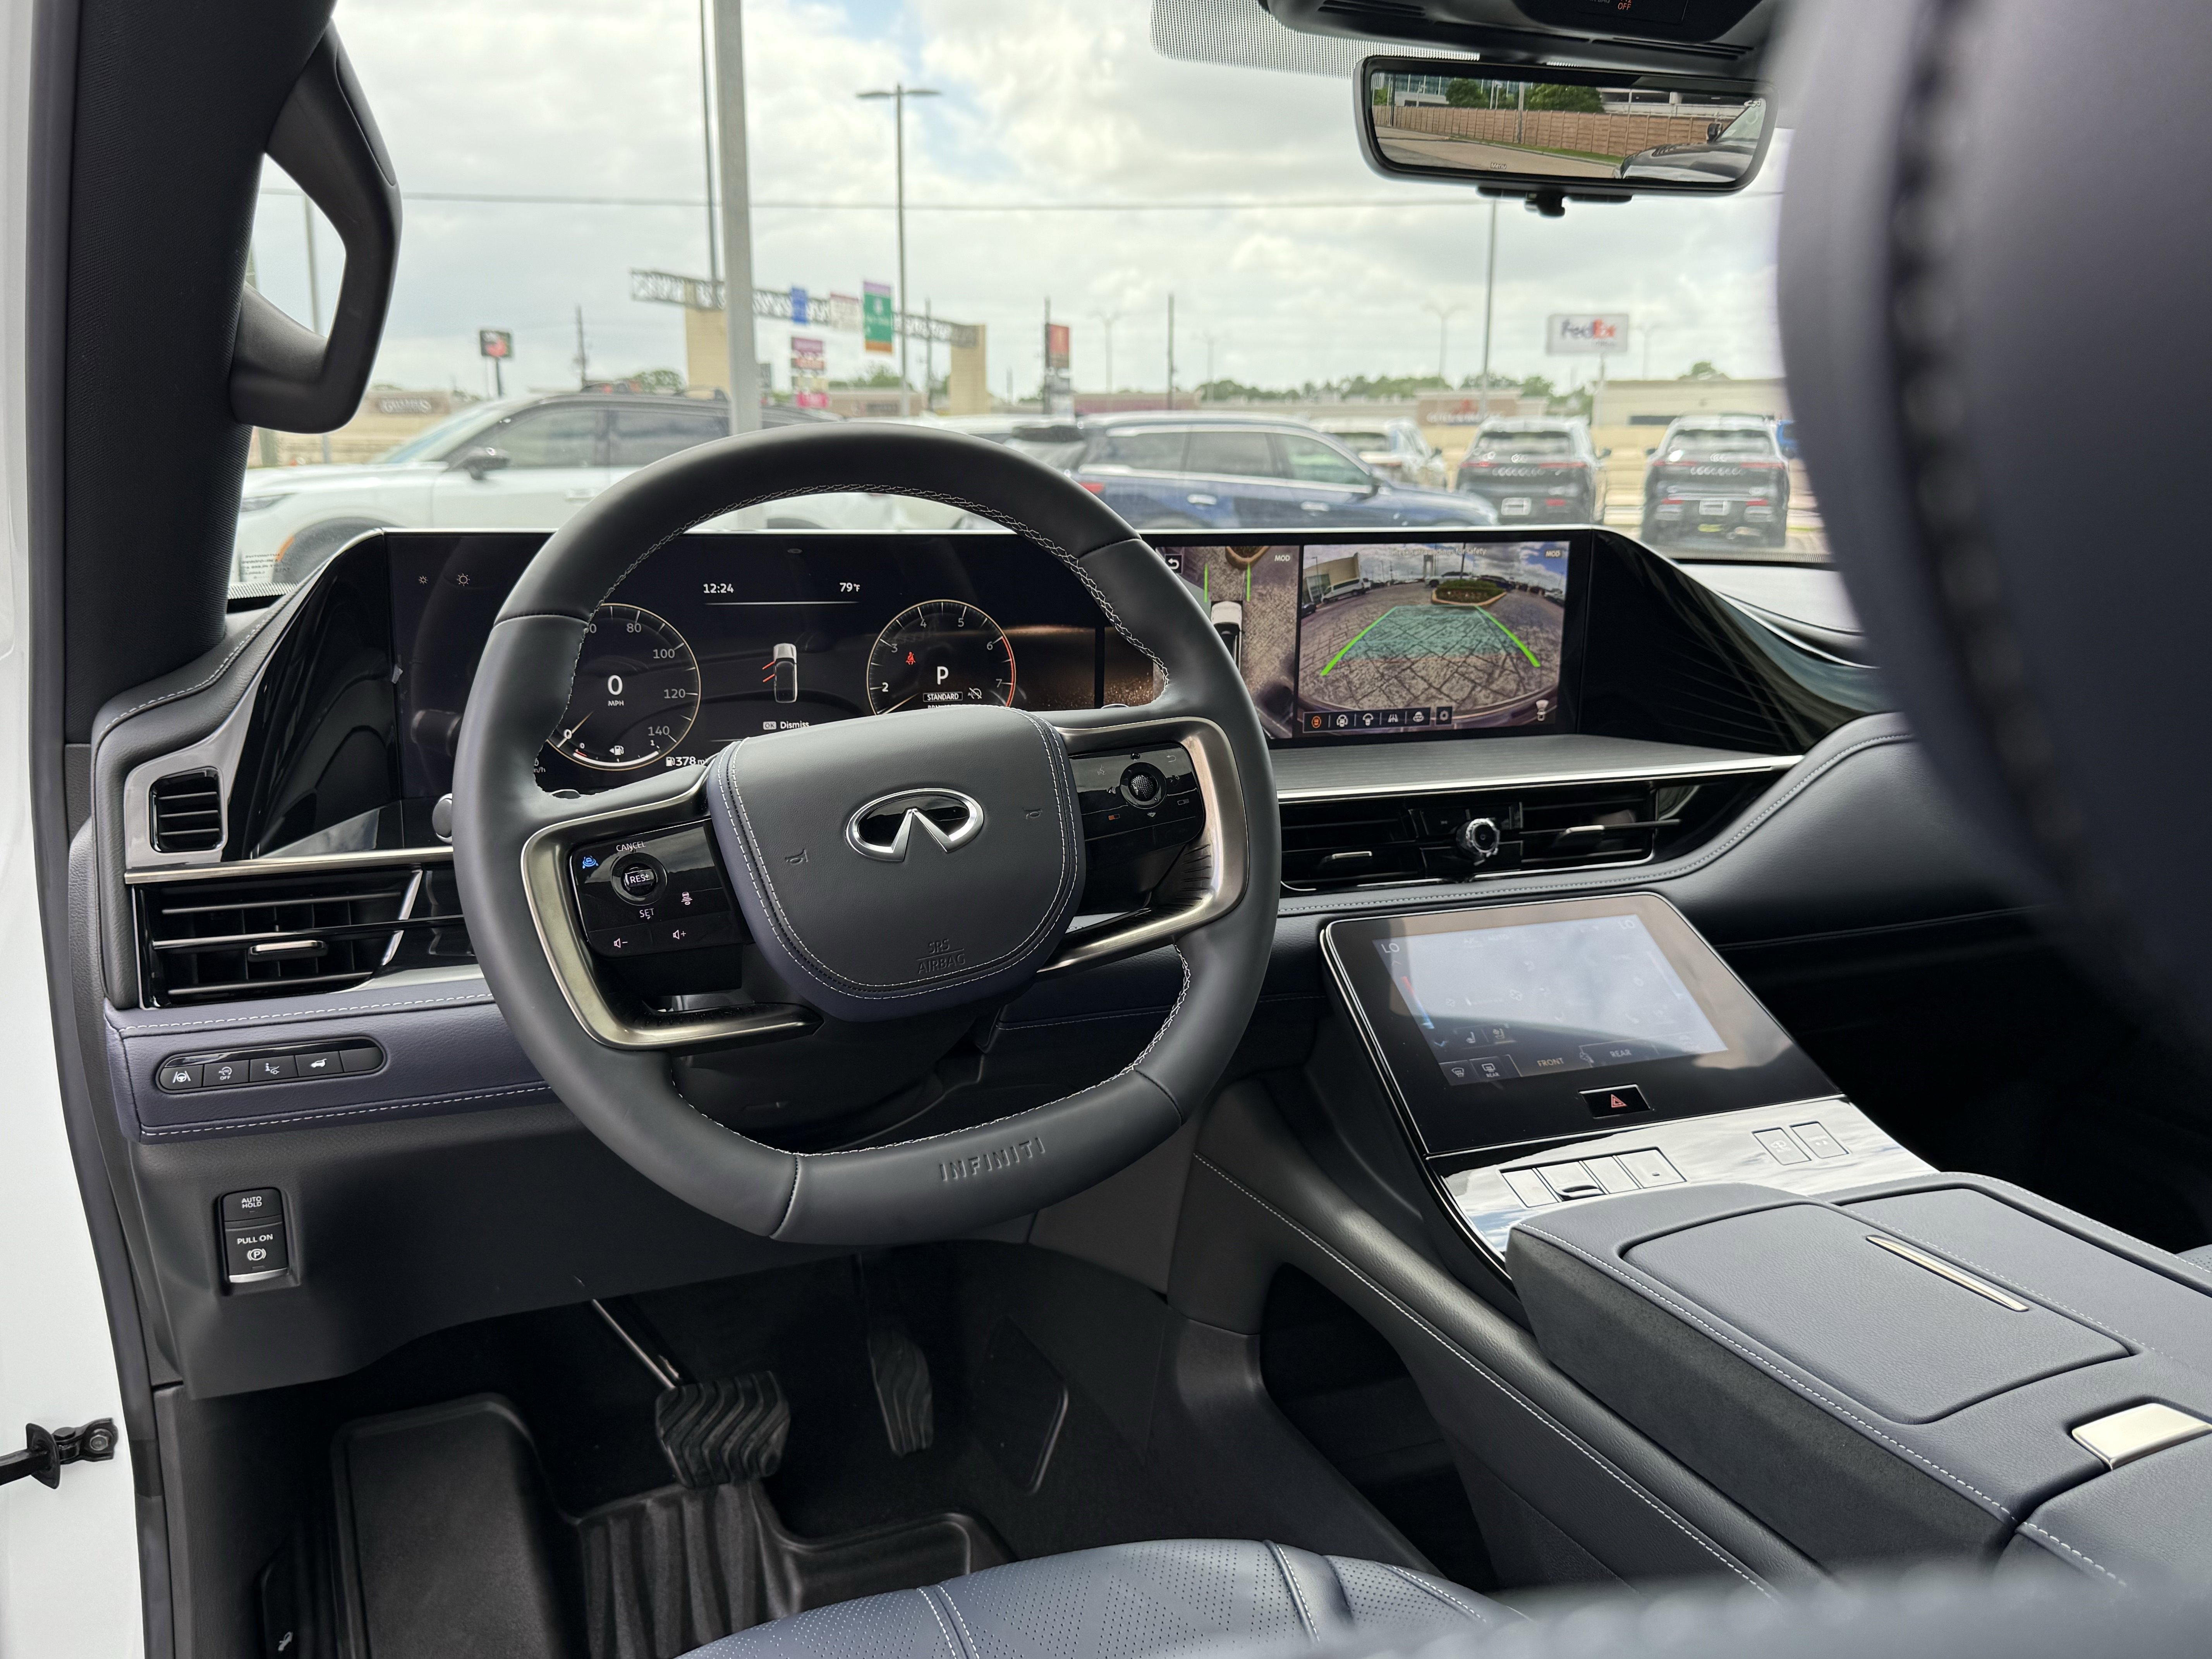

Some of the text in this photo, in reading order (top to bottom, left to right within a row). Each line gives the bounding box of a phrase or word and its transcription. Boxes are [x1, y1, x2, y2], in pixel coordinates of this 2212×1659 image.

[703, 584, 734, 593] 12:24
[920, 619, 926, 628] 4
[958, 618, 964, 627] 5
[584, 623, 597, 634] 0
[627, 623, 642, 633] 80
[891, 644, 898, 653] 3
[987, 642, 993, 650] 6
[653, 649, 675, 659] 100
[937, 666, 949, 685] P
[608, 675, 623, 696] 0
[882, 682, 889, 692] 2
[996, 679, 1002, 687] 7
[664, 689, 685, 699] 120
[780, 720, 810, 729] Dismiss
[563, 729, 572, 739] 0
[648, 725, 670, 736] 140
[675, 756, 696, 766] 378
[616, 841, 646, 852] CANCEL
[639, 908, 654, 918] SET
[929, 939, 950, 954] SRS
[1381, 943, 1400, 953] LO
[918, 953, 965, 974] AIRBAG
[1609, 1049, 1632, 1058] REAR
[1537, 1058, 1565, 1067] FRONT
[939, 1137, 1045, 1182] INFINITI
